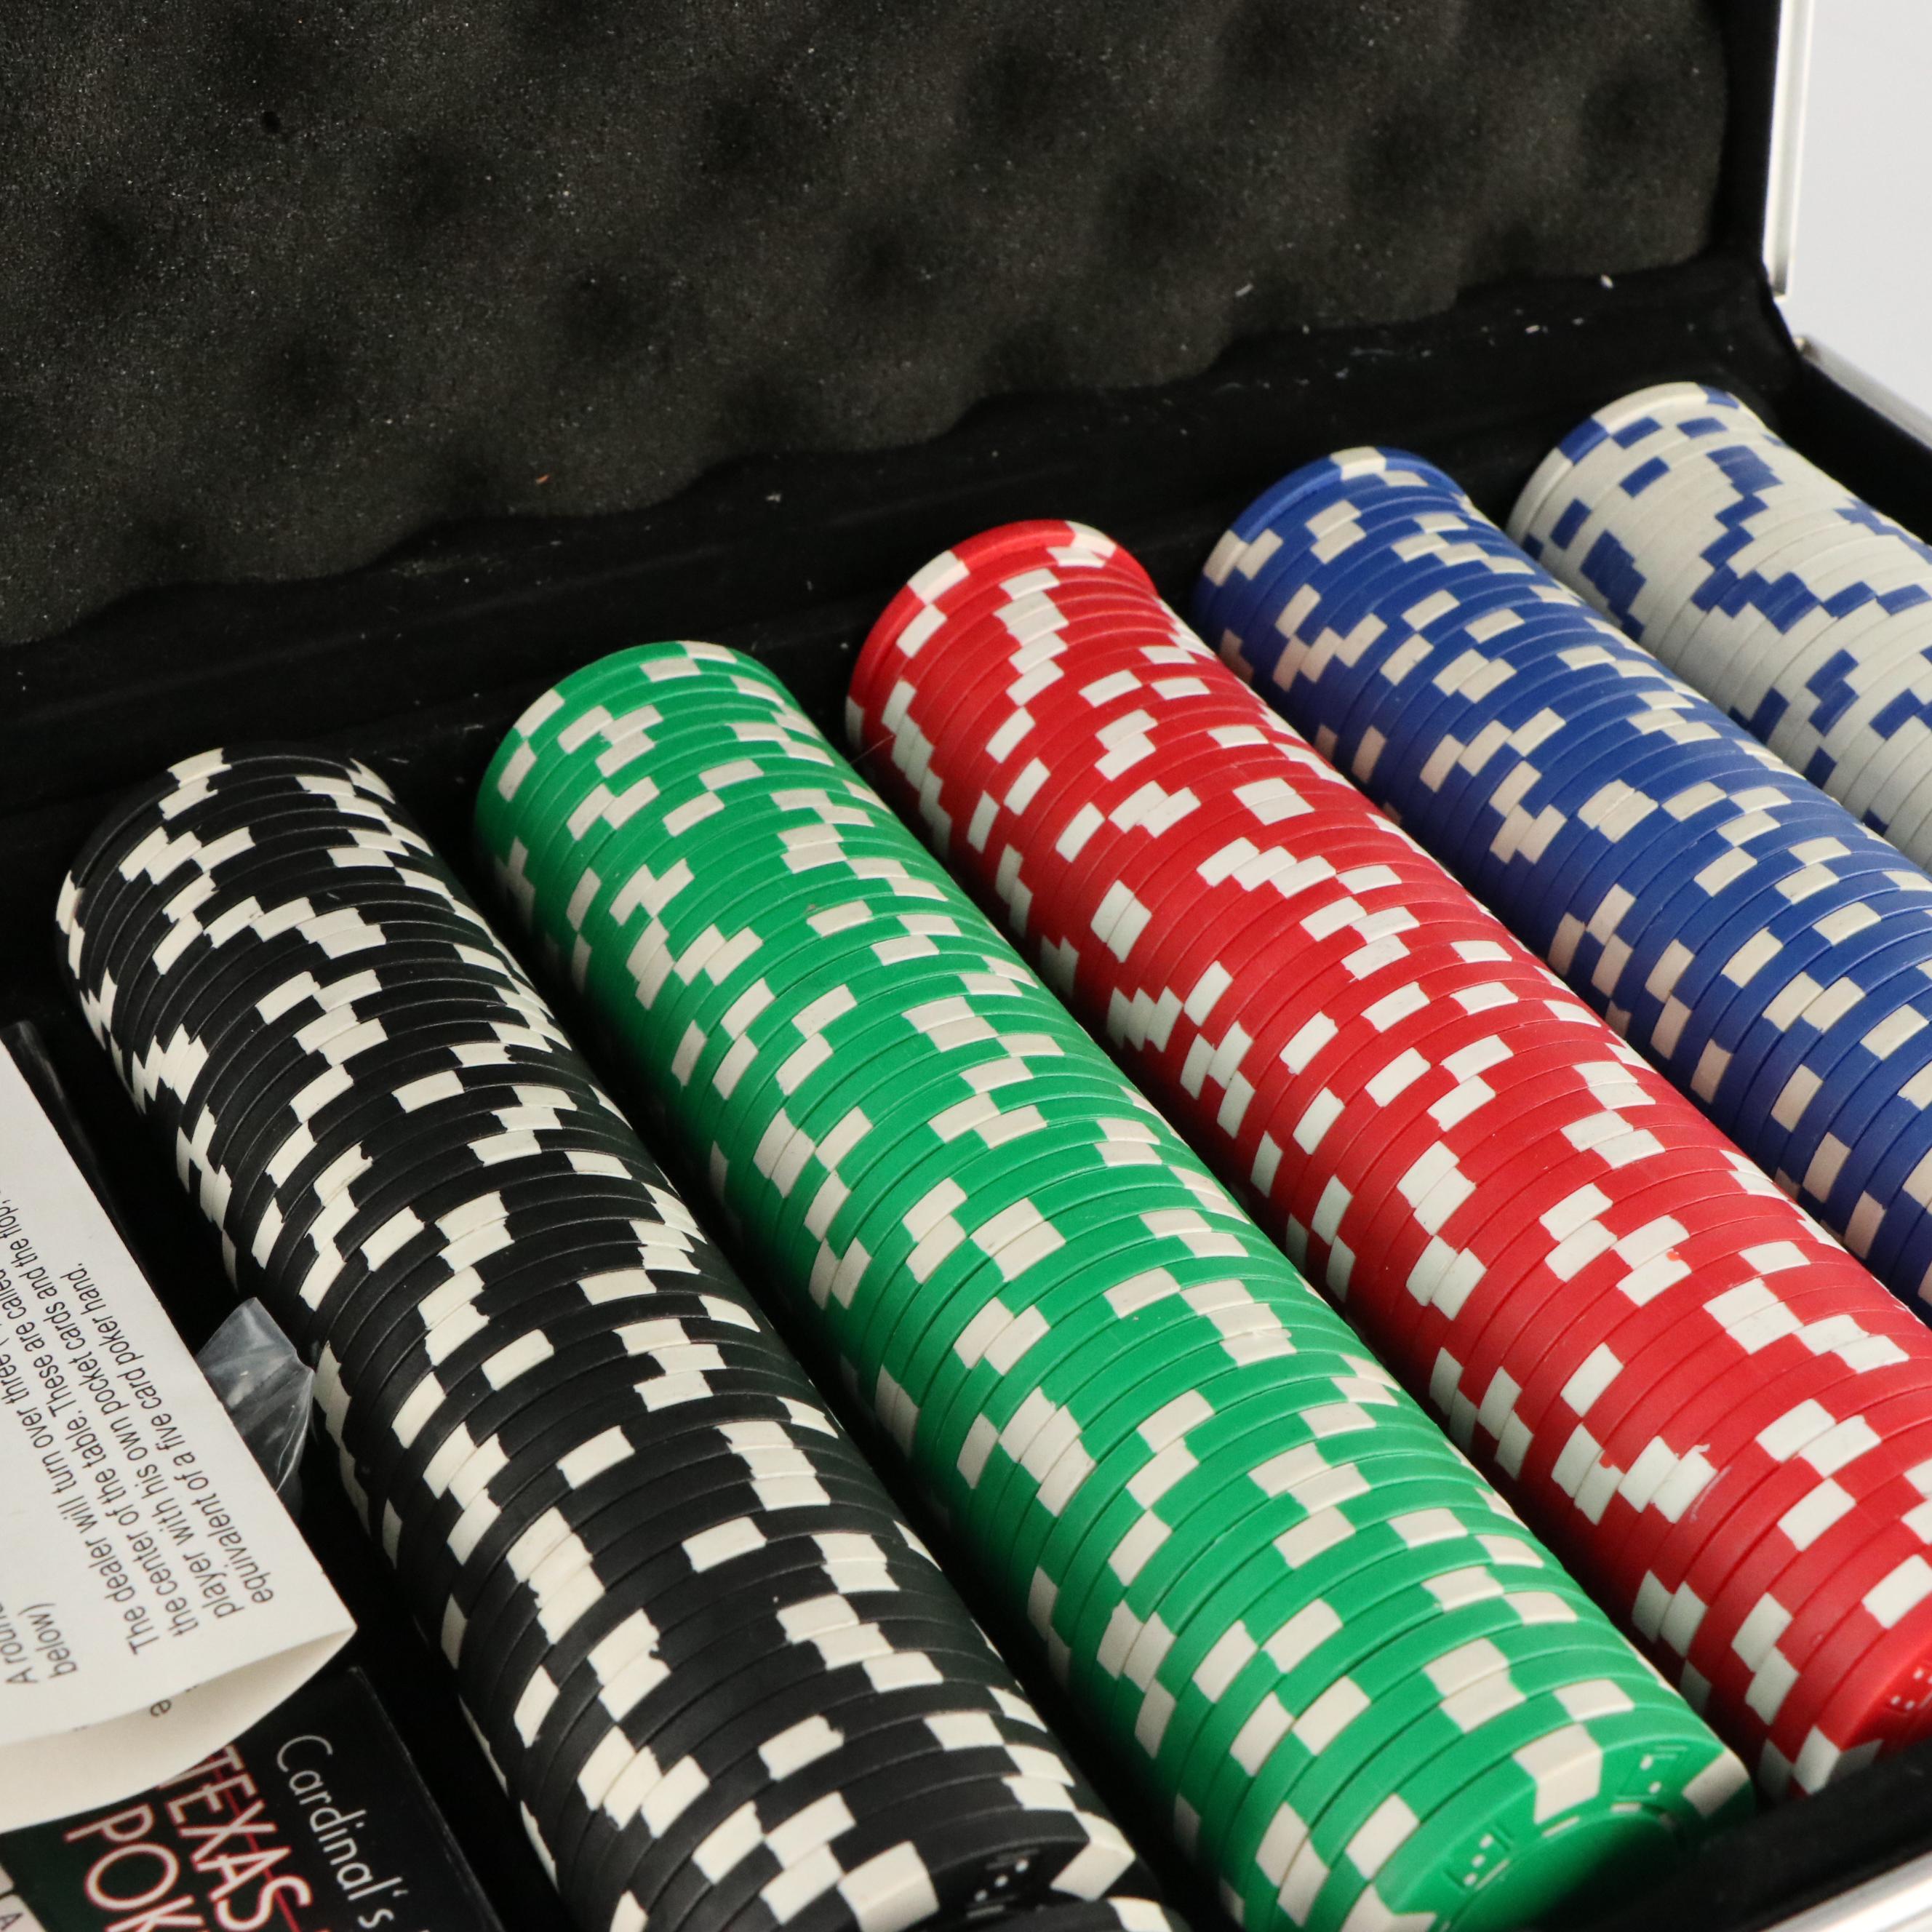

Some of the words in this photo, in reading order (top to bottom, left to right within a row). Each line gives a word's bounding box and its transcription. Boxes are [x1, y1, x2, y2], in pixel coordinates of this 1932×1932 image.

[9, 1238, 39, 1269] the
[0, 1268, 27, 1320] calle
[17, 1266, 58, 1300] and
[59, 1262, 107, 1316] hand.
[15, 1321, 46, 1353] are
[42, 1301, 87, 1351] cards
[91, 1315, 145, 1366] poker
[33, 1354, 77, 1418] These
[68, 1351, 130, 1416] pocket
[116, 1367, 162, 1410] card
[16, 1407, 55, 1449] over
[65, 1410, 107, 1469] table.
[109, 1416, 148, 1461] own
[151, 1413, 185, 1451] five
[41, 1450, 77, 1495] turn
[134, 1464, 169, 1500] his
[172, 1451, 196, 1466] a
[173, 1470, 209, 1490] of
[95, 1468, 127, 1505] the
[57, 1495, 98, 1534] will
[105, 1504, 140, 1526] of
[151, 1497, 195, 1546] with
[84, 1537, 136, 1602] dealer
[126, 1530, 178, 1596] center
[191, 1493, 274, 1603] equivalent
[182, 1552, 245, 1618] player
[18, 1602, 78, 1679] below)
[123, 1606, 159, 1655] The
[164, 1597, 199, 1637] the
[5, 1666, 39, 1684] A
[155, 1744, 313, 1932] TEXAS
[276, 1734, 409, 1929] Cardinal's
[63, 1803, 209, 1932] POK
